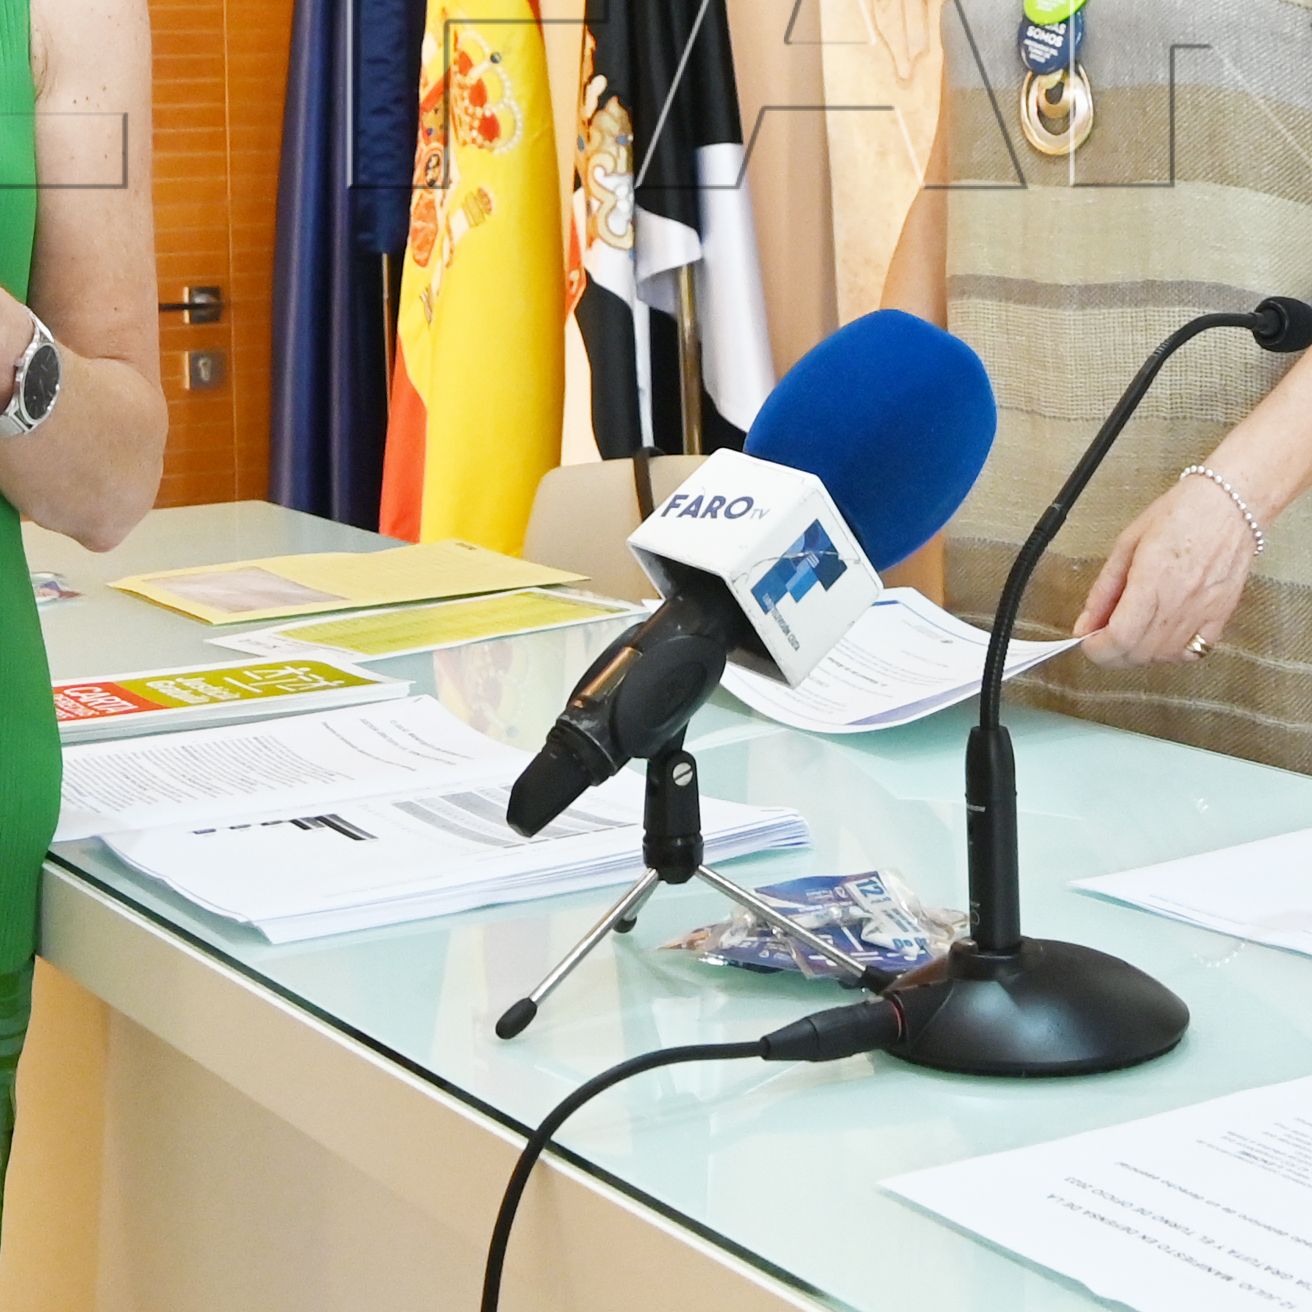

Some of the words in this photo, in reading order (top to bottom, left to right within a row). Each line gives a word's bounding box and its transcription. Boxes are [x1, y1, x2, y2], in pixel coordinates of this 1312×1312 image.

[1027, 26, 1064, 48] SOMOS
[661, 494, 755, 519] FARO
[750, 508, 770, 520] TV
[64, 686, 140, 714] CARTA
[856, 880, 886, 898] 12
